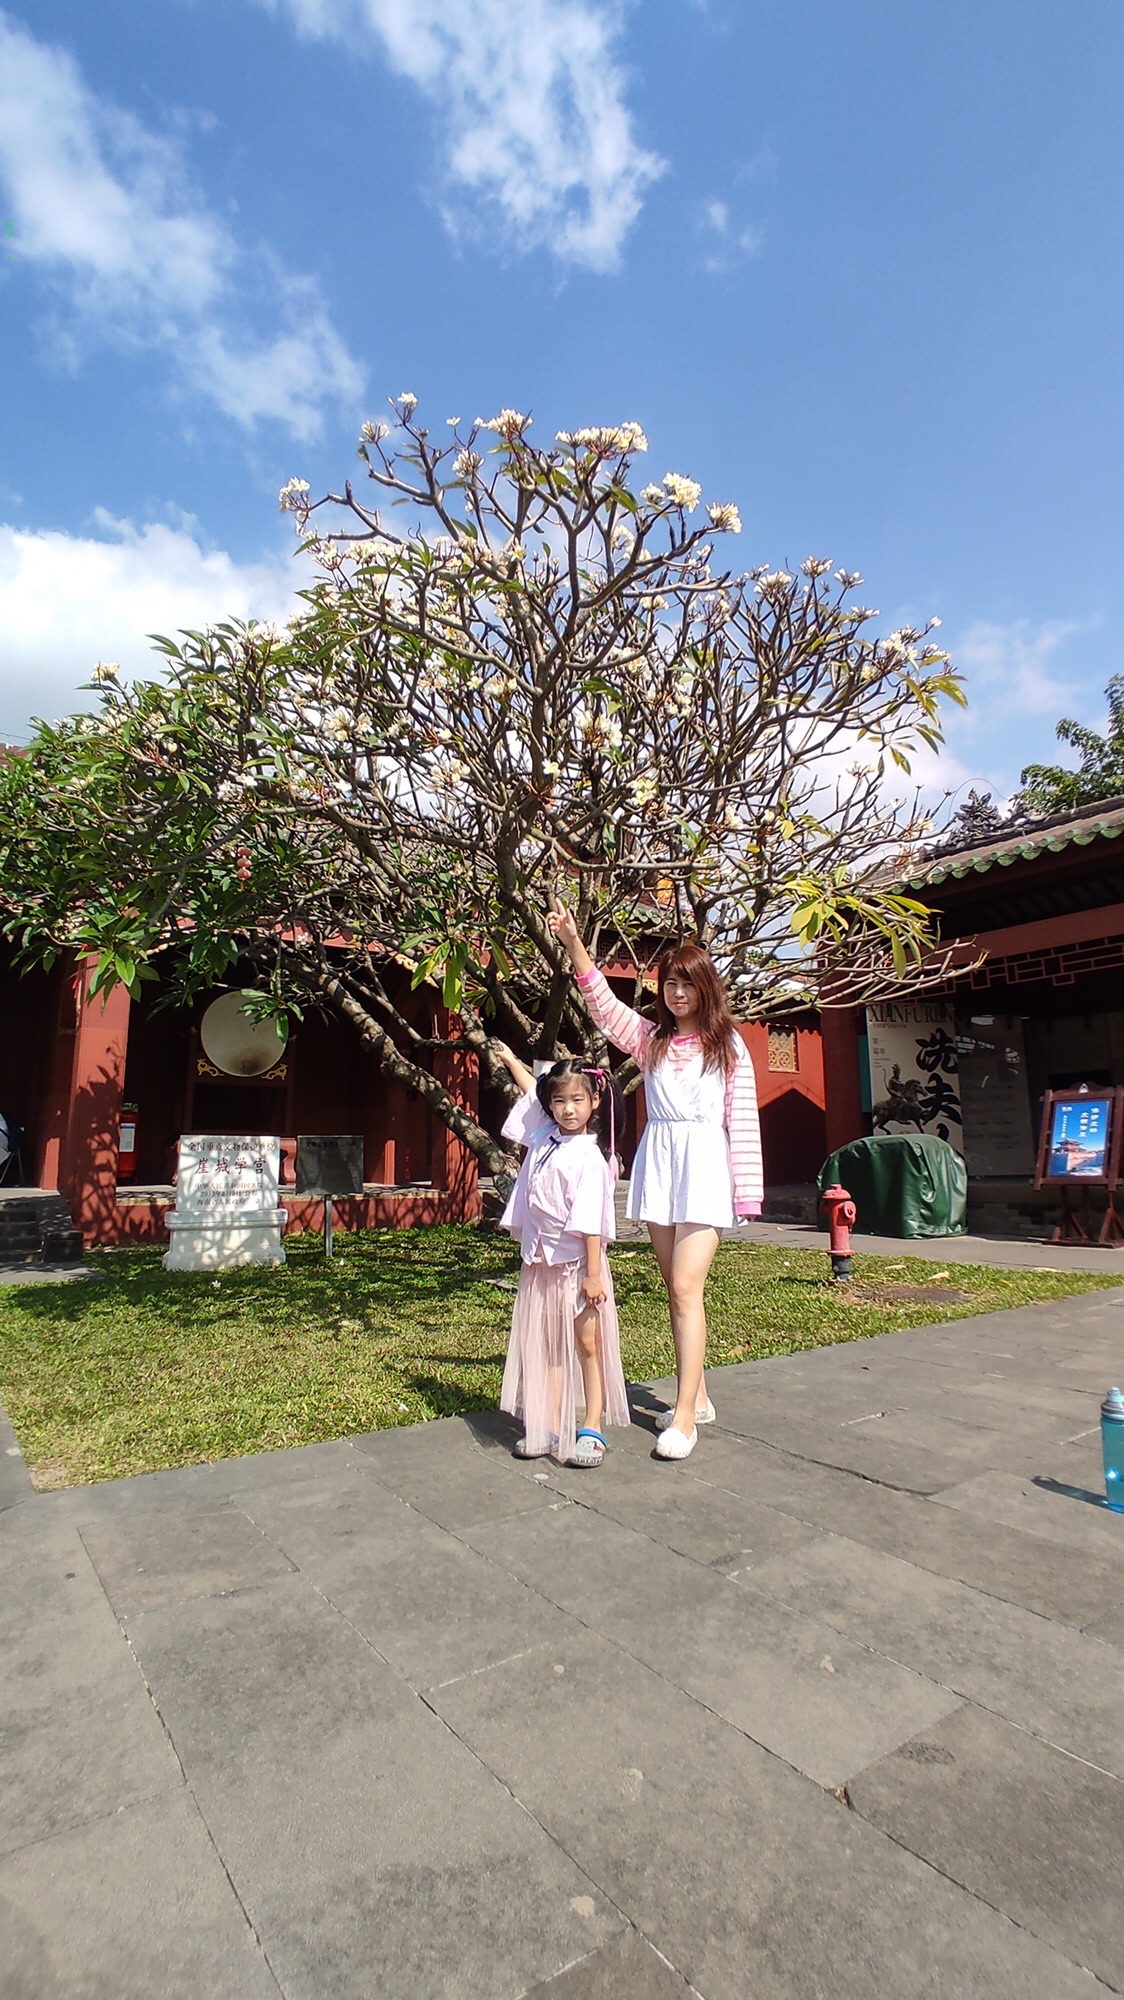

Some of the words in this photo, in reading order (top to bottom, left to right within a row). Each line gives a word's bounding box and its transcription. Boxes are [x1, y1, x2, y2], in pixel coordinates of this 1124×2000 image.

[188, 1141, 275, 1152] 全国重点文物保护单位
[194, 1157, 266, 1175] 崖城学宫
